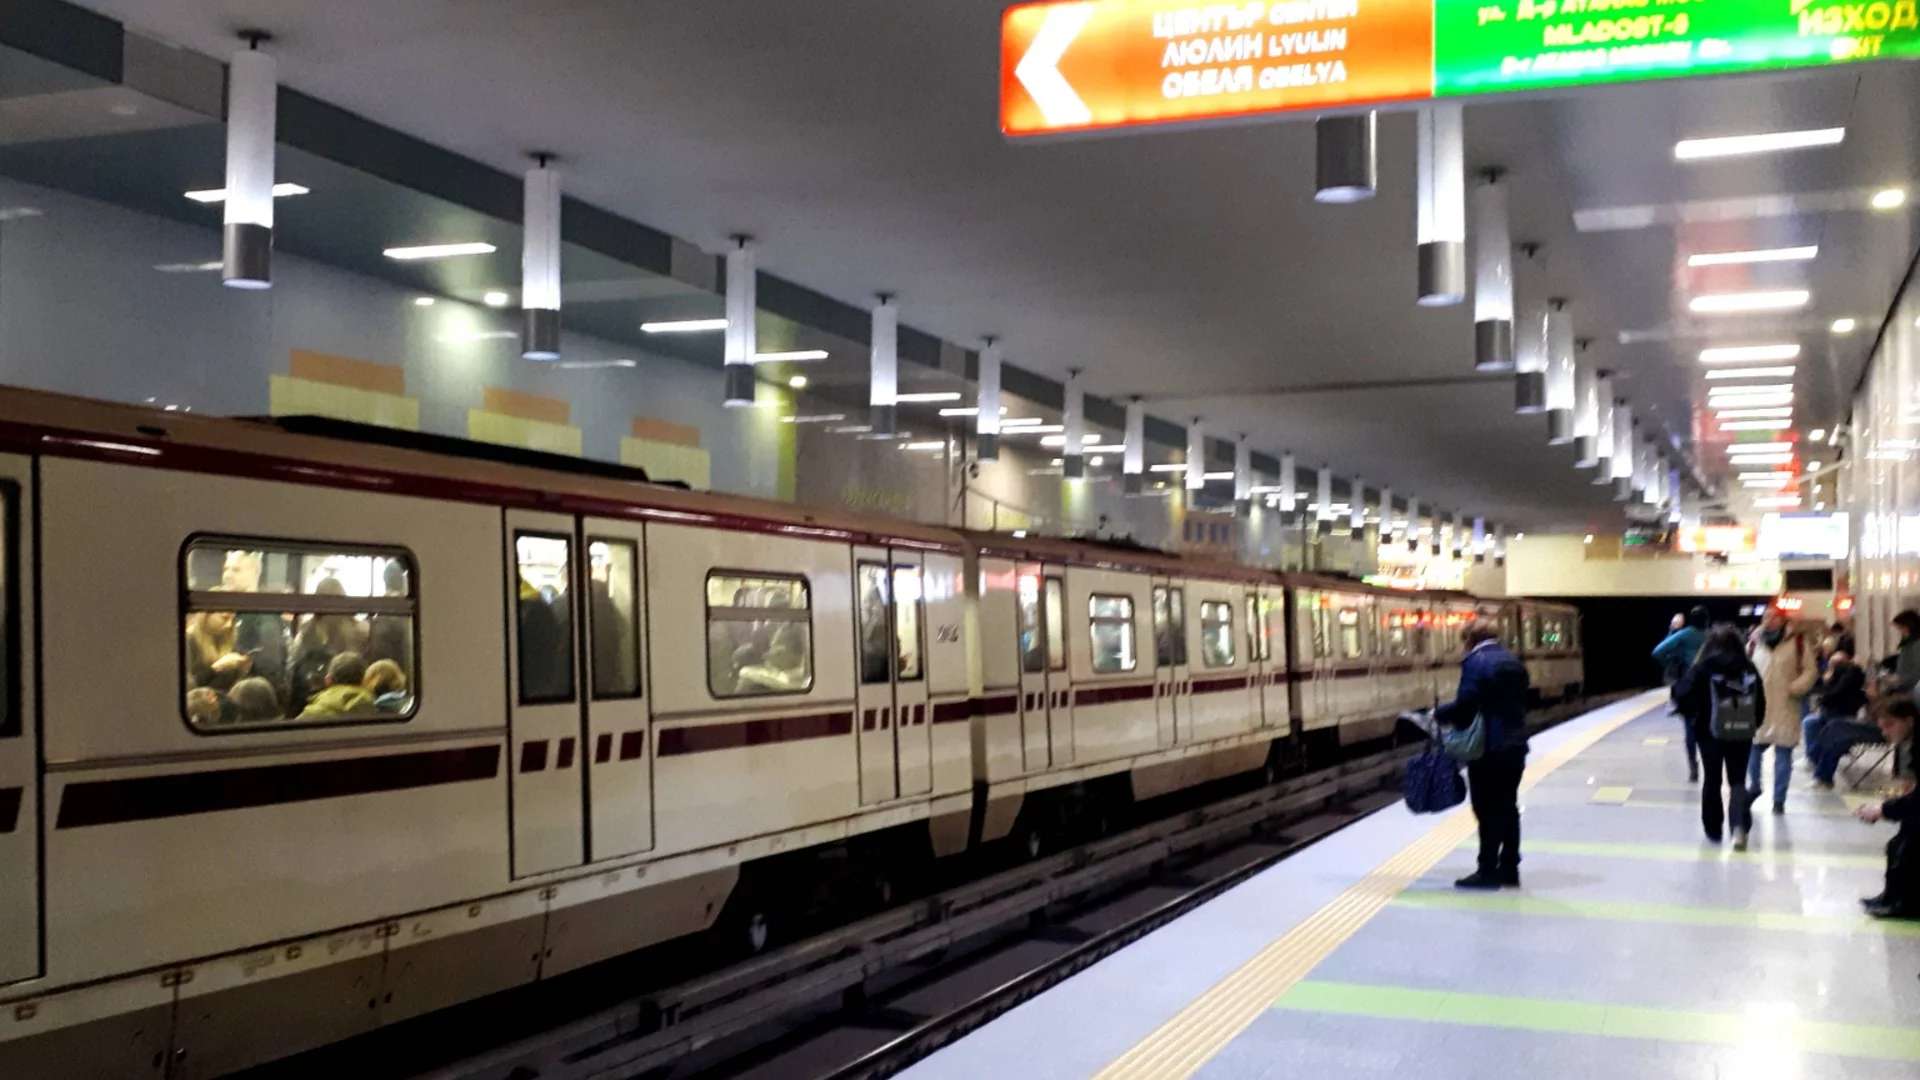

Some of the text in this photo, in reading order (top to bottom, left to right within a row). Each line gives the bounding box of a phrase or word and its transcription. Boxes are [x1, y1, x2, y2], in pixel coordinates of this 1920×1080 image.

[1798, 0, 1918, 37] ИЗХОД
[1161, 32, 1263, 67] ЛЮЛИН
[1268, 28, 1347, 57] LYULIN
